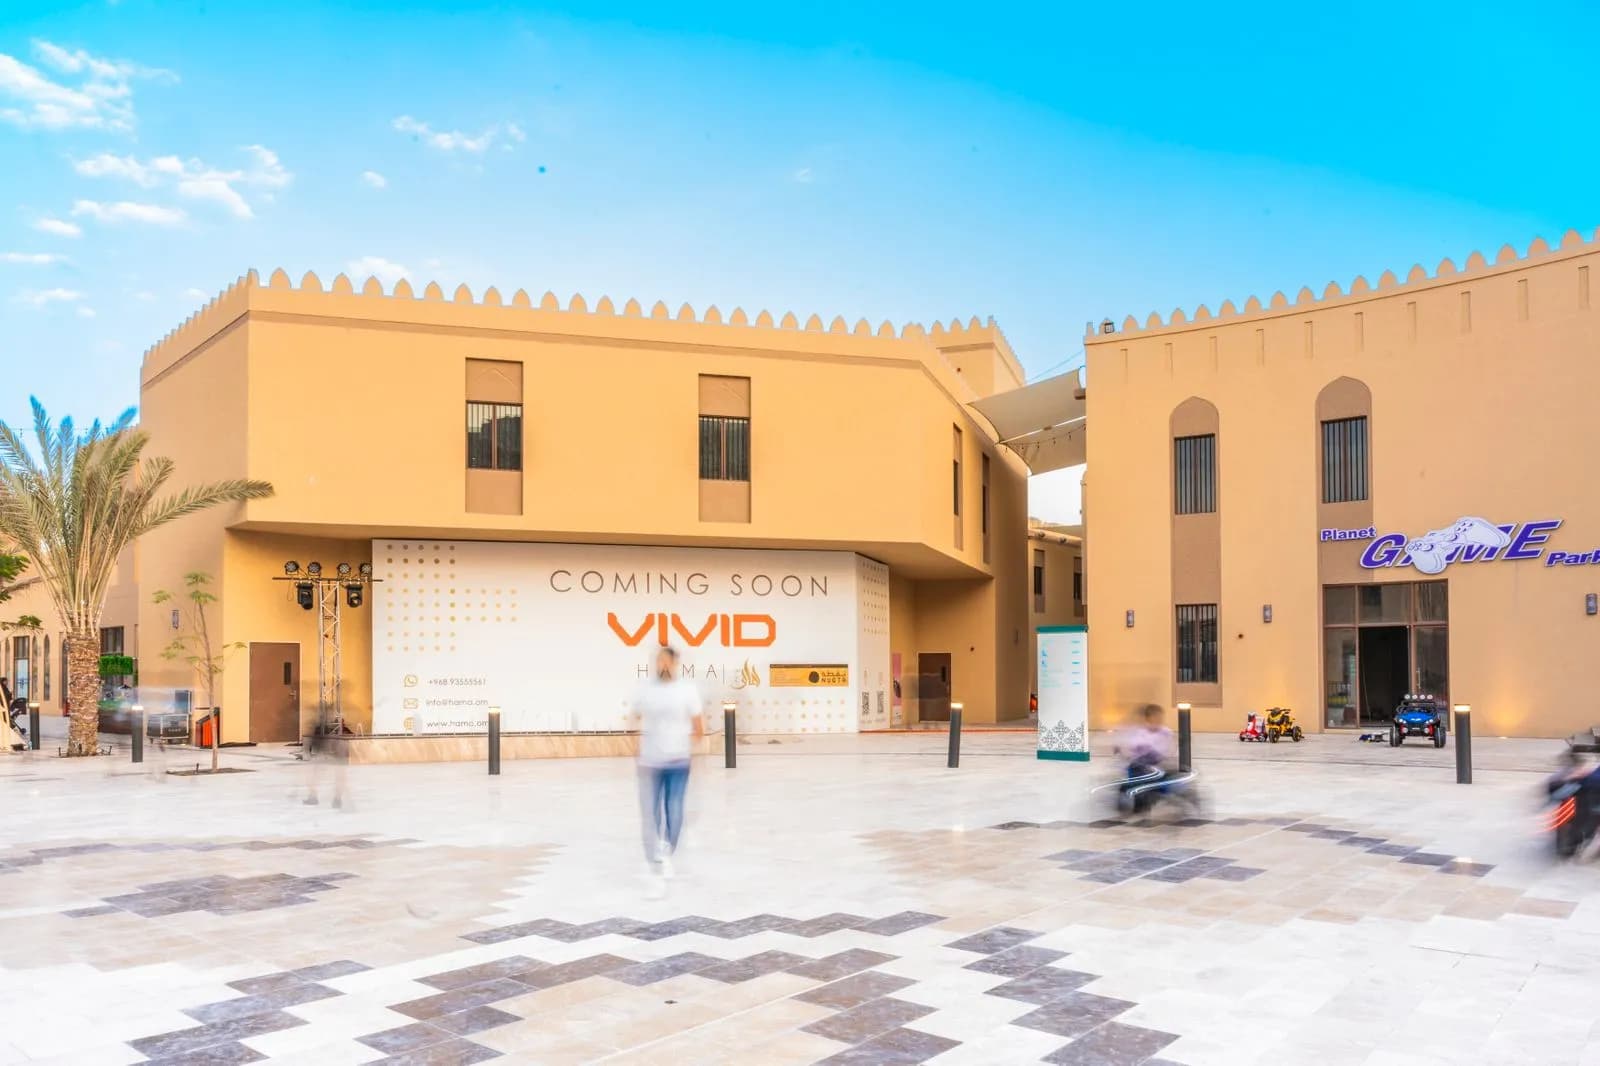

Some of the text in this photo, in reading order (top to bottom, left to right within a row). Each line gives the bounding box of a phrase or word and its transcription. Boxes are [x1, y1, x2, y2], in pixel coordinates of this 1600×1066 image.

[1320, 526, 1378, 542] Planet
[1359, 519, 1563, 569] GME
[549, 569, 829, 598] COMING SOON
[607, 612, 777, 648] VIVID
